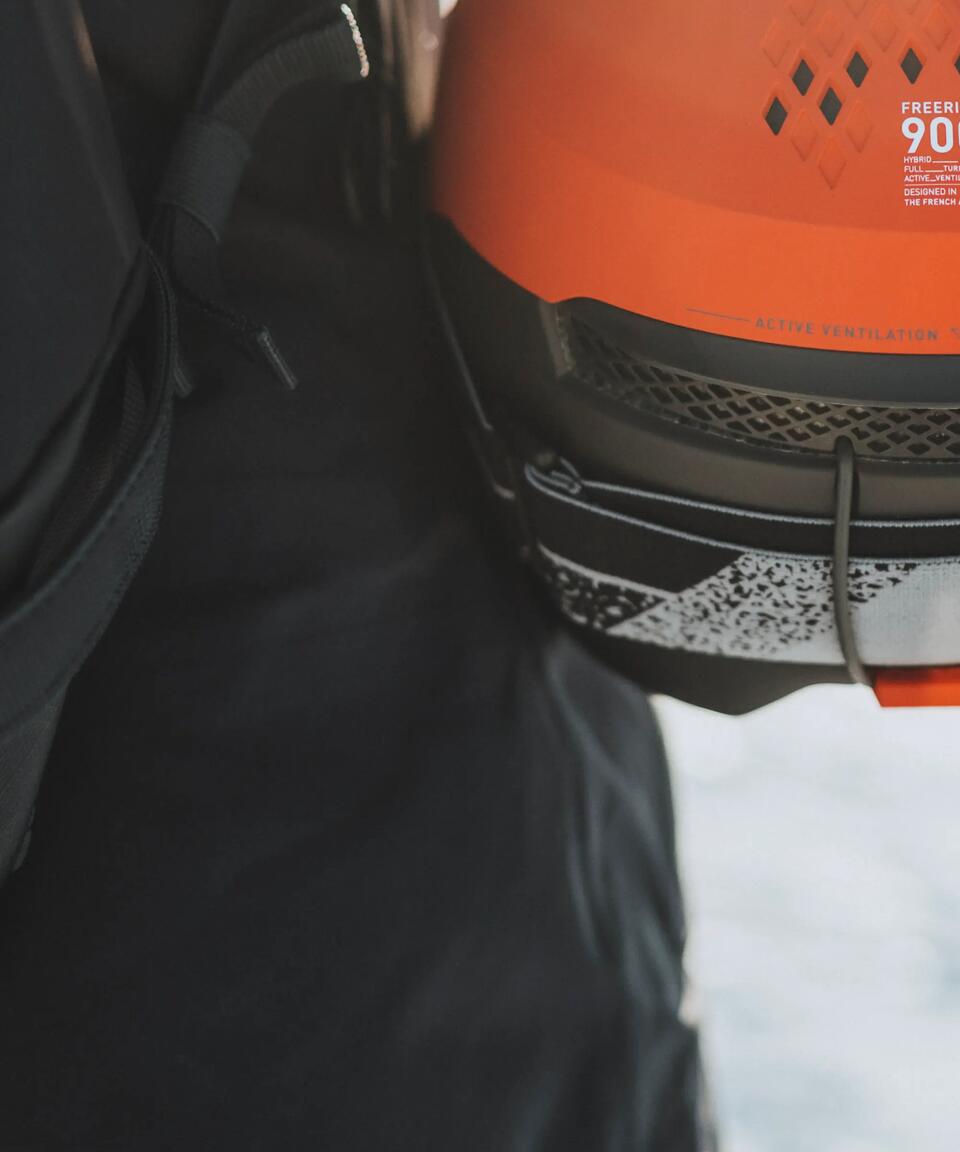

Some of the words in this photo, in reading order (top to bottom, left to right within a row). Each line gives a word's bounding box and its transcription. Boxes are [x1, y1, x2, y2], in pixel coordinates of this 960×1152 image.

[903, 155, 932, 163] HYBRID
[903, 165, 924, 173] FULL
[903, 188, 946, 196] DESIGNED
[947, 188, 958, 196] IN
[904, 198, 921, 206] THE
[922, 198, 957, 206] FRENCH
[755, 316, 816, 335] ACTIVE
[821, 324, 939, 342] VENTILATION
